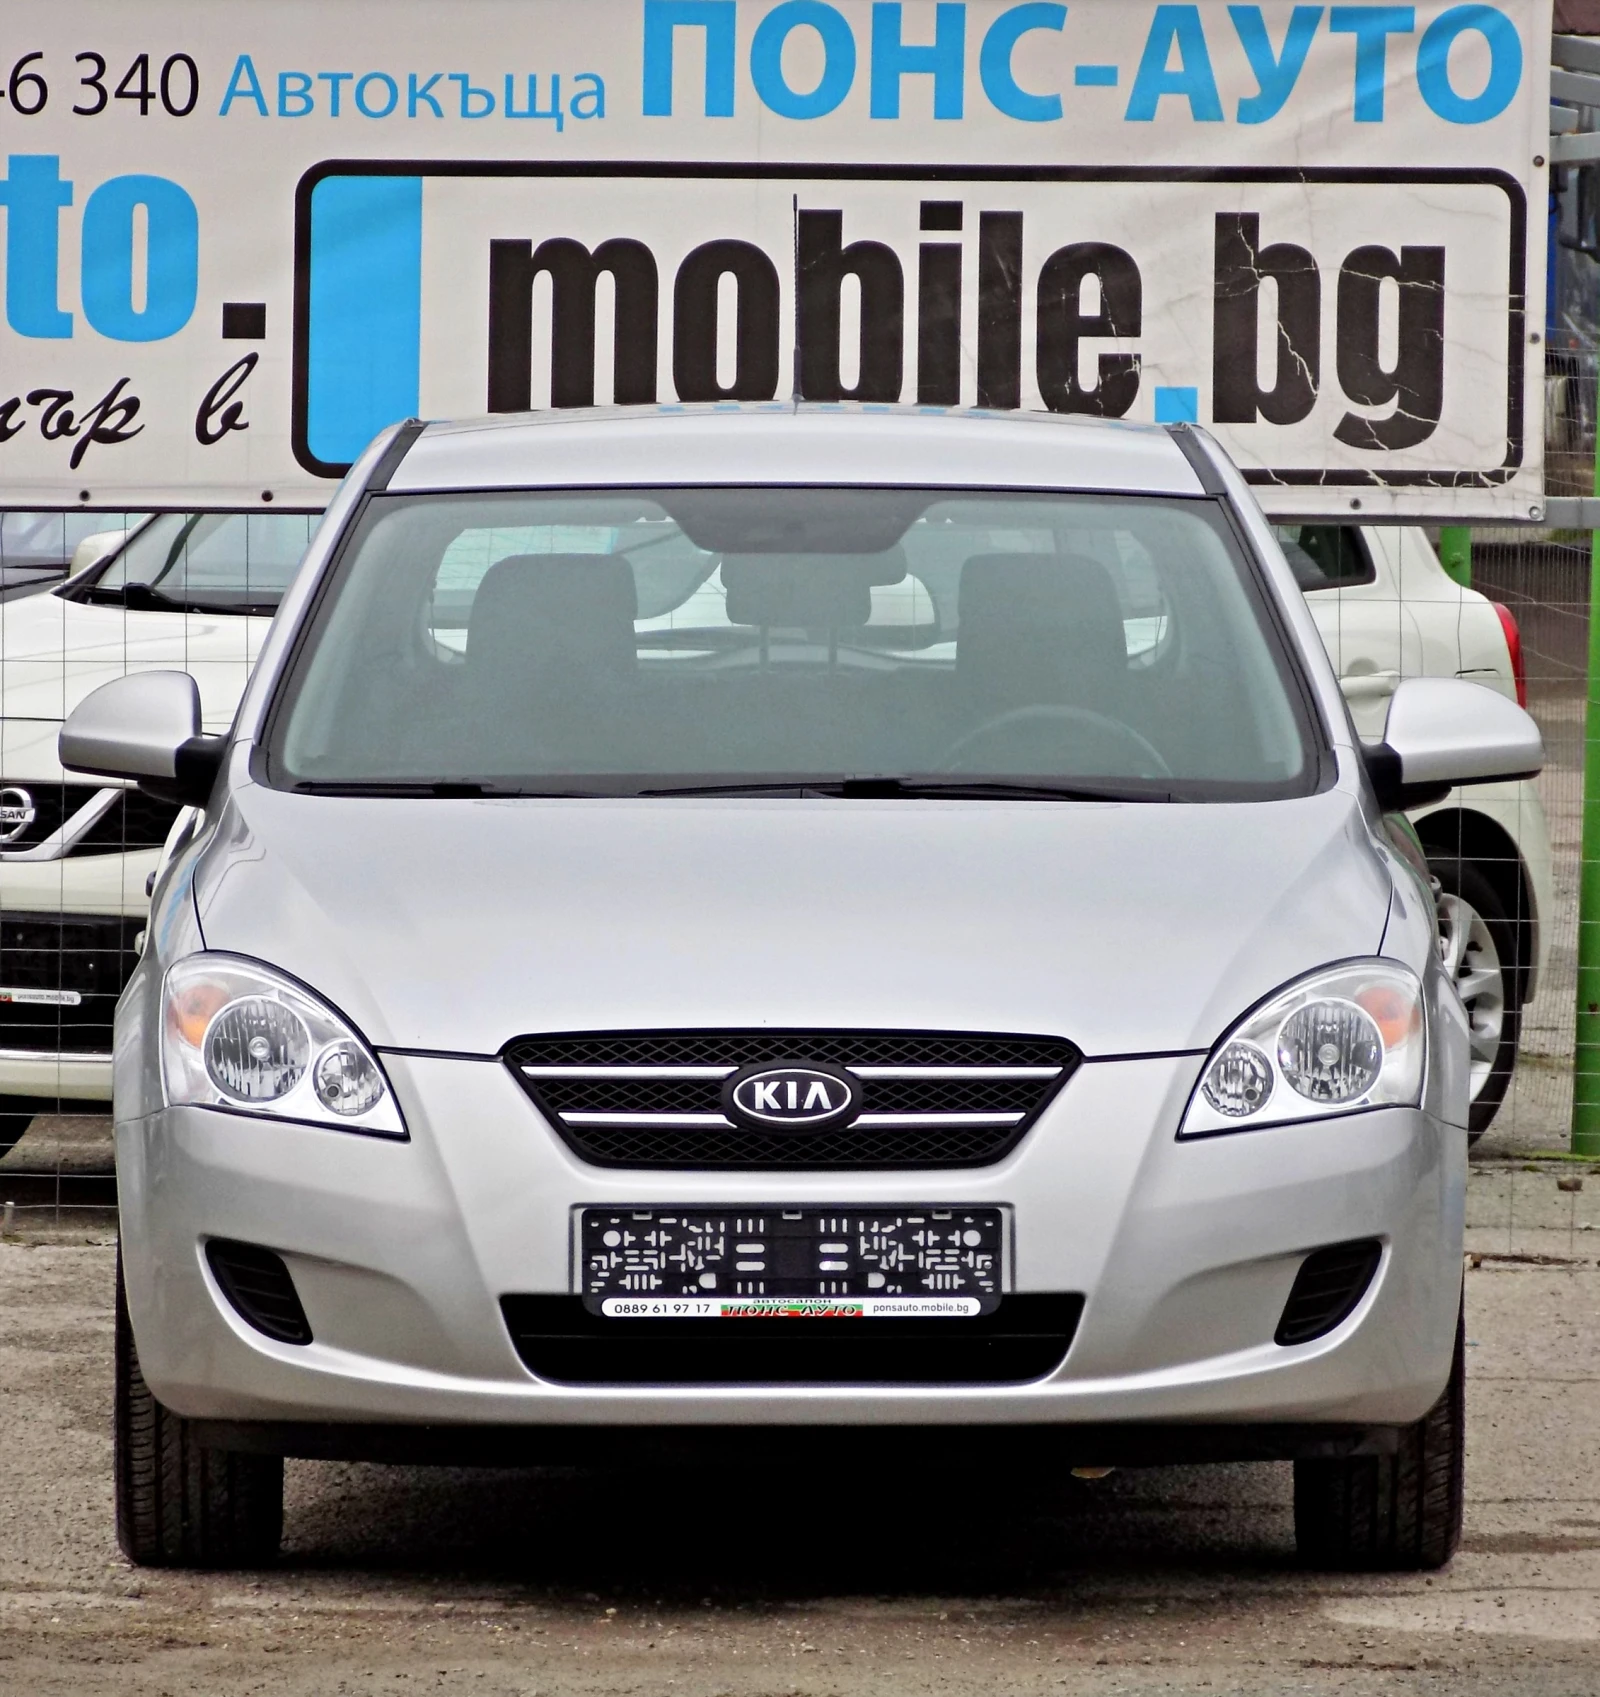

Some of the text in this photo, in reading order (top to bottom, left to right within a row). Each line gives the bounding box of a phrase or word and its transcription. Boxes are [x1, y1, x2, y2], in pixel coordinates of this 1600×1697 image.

[218, 0, 1524, 132] Автокъща ПОНС-АУТО
[0, 51, 200, 117] 6 340
[487, 200, 1446, 450] mobile.bg
[752, 1080, 832, 1110] KIA
[614, 1304, 711, 1314] 0889 61 97 17
[728, 1305, 858, 1317] ПОНС АУТО
[873, 1303, 969, 1314] ponsauto.mobile.bg
